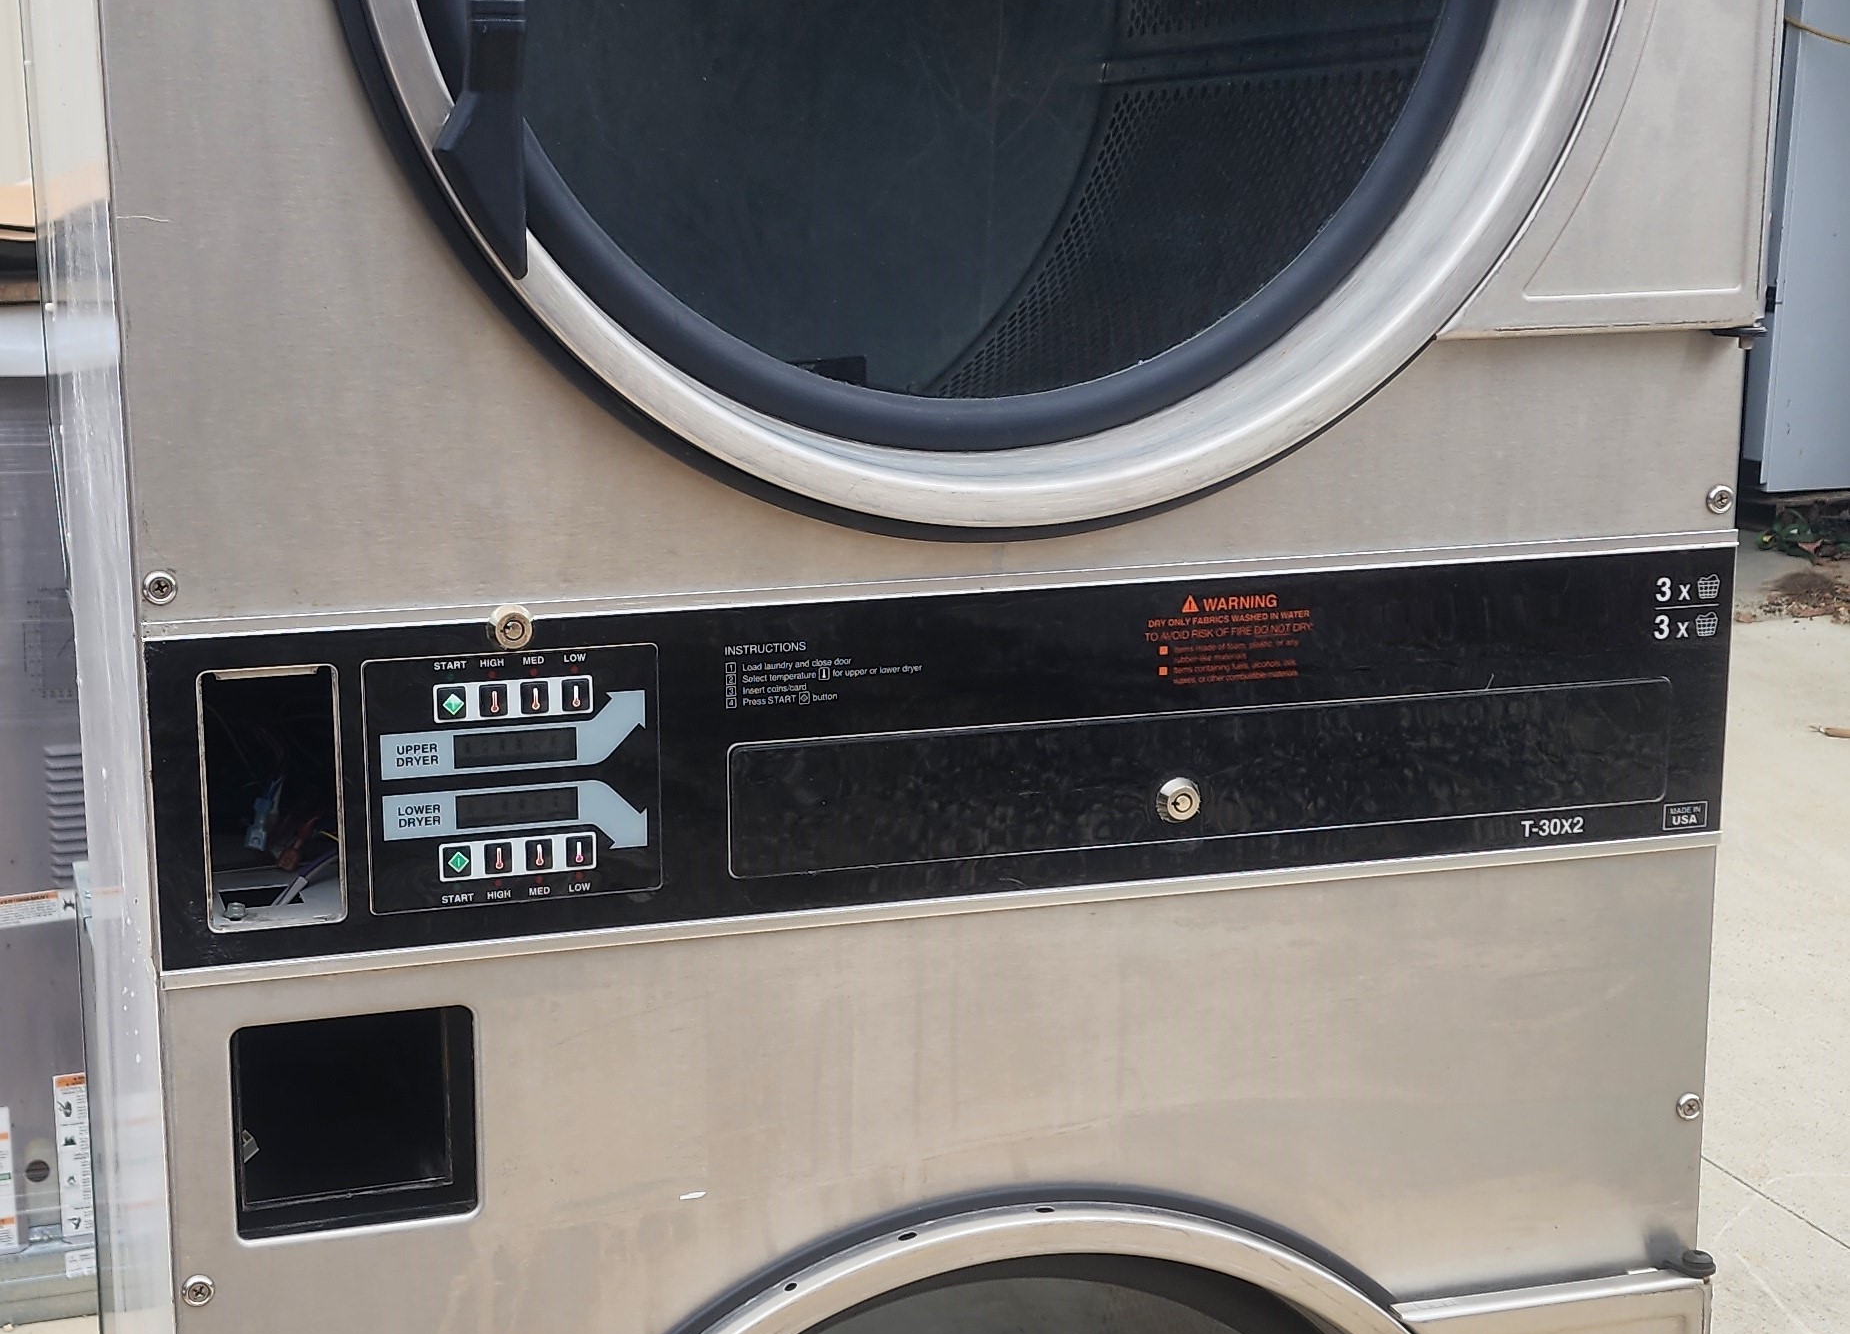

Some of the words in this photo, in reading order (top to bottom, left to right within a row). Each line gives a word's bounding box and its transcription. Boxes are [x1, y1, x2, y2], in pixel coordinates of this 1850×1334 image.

[1655, 577, 1672, 602] 3
[1678, 583, 1691, 601] x
[1203, 594, 1277, 611] WARNING
[1148, 619, 1167, 628] DRY
[1168, 617, 1191, 626] ONLY
[1192, 615, 1229, 625] FABRICS
[1231, 613, 1268, 622] WASHED
[1269, 612, 1279, 620] IN
[1280, 610, 1310, 619] WATER
[1653, 615, 1670, 639] 3
[1676, 621, 1689, 638] x
[1144, 632, 1159, 641] TO
[1160, 630, 1190, 640] AVOID
[1191, 628, 1215, 638] RISK
[1215, 627, 1230, 637] OF
[1231, 626, 1252, 635] FIRE
[1254, 625, 1269, 635] DO
[1270, 623, 1291, 633] NOT
[724, 642, 806, 656] INSTRUCTIONS
[433, 660, 467, 671] START
[480, 658, 505, 668] HIGH
[522, 655, 545, 665] MED
[563, 653, 586, 663] LOW
[742, 663, 762, 672] Load
[764, 661, 793, 670] laundry
[794, 660, 810, 668] and
[833, 657, 852, 666] door
[742, 674, 767, 683] Select
[769, 671, 817, 682] temperature
[832, 668, 844, 677] for
[844, 668, 868, 678] upper
[869, 667, 878, 675] or
[879, 666, 901, 674] lower
[901, 664, 923, 674] dryer
[742, 687, 766, 695] Insert
[742, 697, 767, 707] Press
[767, 694, 797, 704] START
[812, 693, 838, 702] button
[396, 743, 438, 755] UPPER
[396, 755, 439, 767] DRYER
[398, 804, 441, 817] LOWER
[398, 816, 441, 828] DRYER
[1521, 817, 1584, 838] T-30X2
[1672, 814, 1698, 826] USA
[441, 892, 474, 904] START
[487, 890, 511, 900] HIGH
[528, 886, 551, 897] MED
[568, 882, 591, 893] LOW
